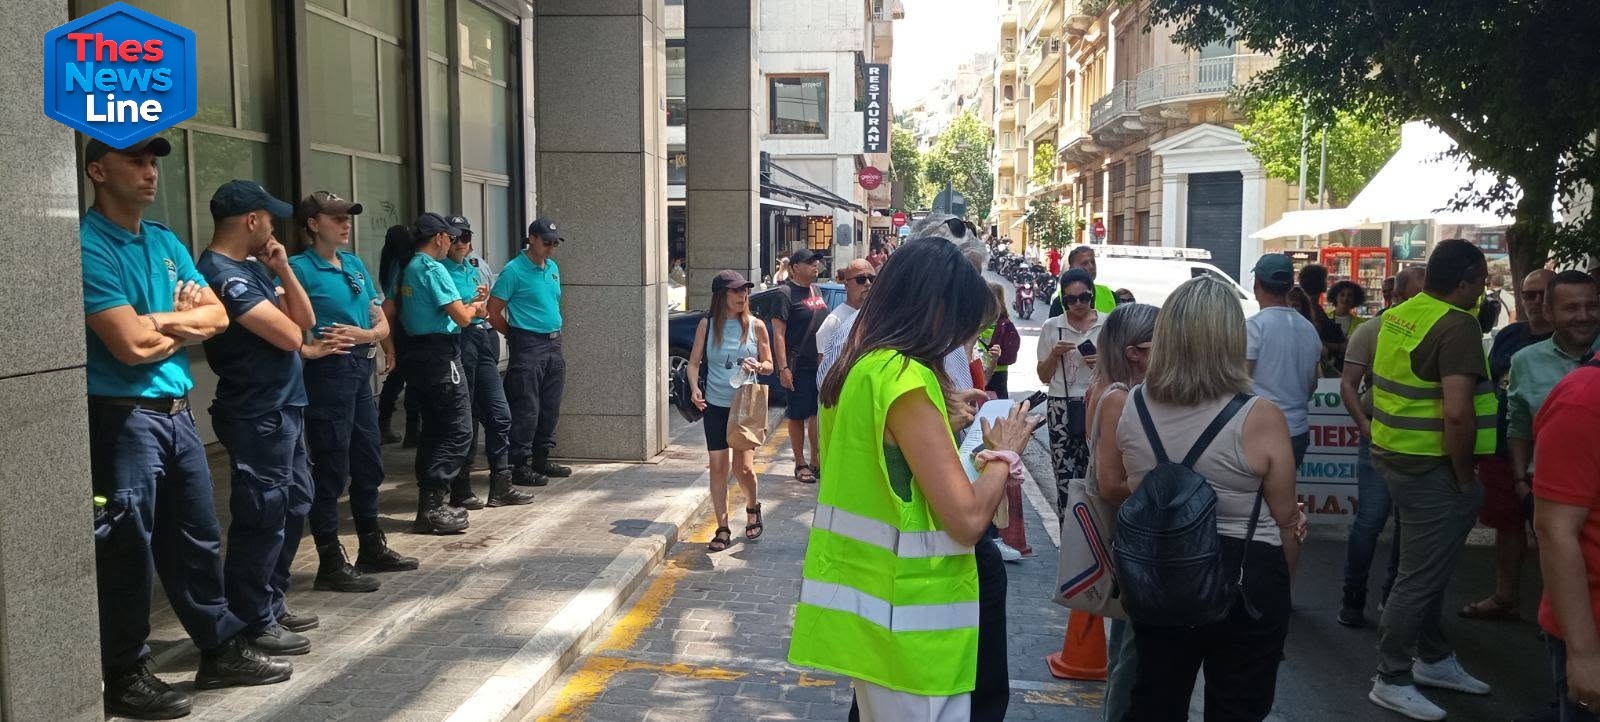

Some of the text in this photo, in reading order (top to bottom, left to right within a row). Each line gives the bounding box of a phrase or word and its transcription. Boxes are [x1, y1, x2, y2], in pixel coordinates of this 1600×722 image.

[802, 81, 822, 89] project
[868, 67, 881, 151] RESTAURANT
[1299, 462, 1359, 478] ΗΜΟΣΙ
